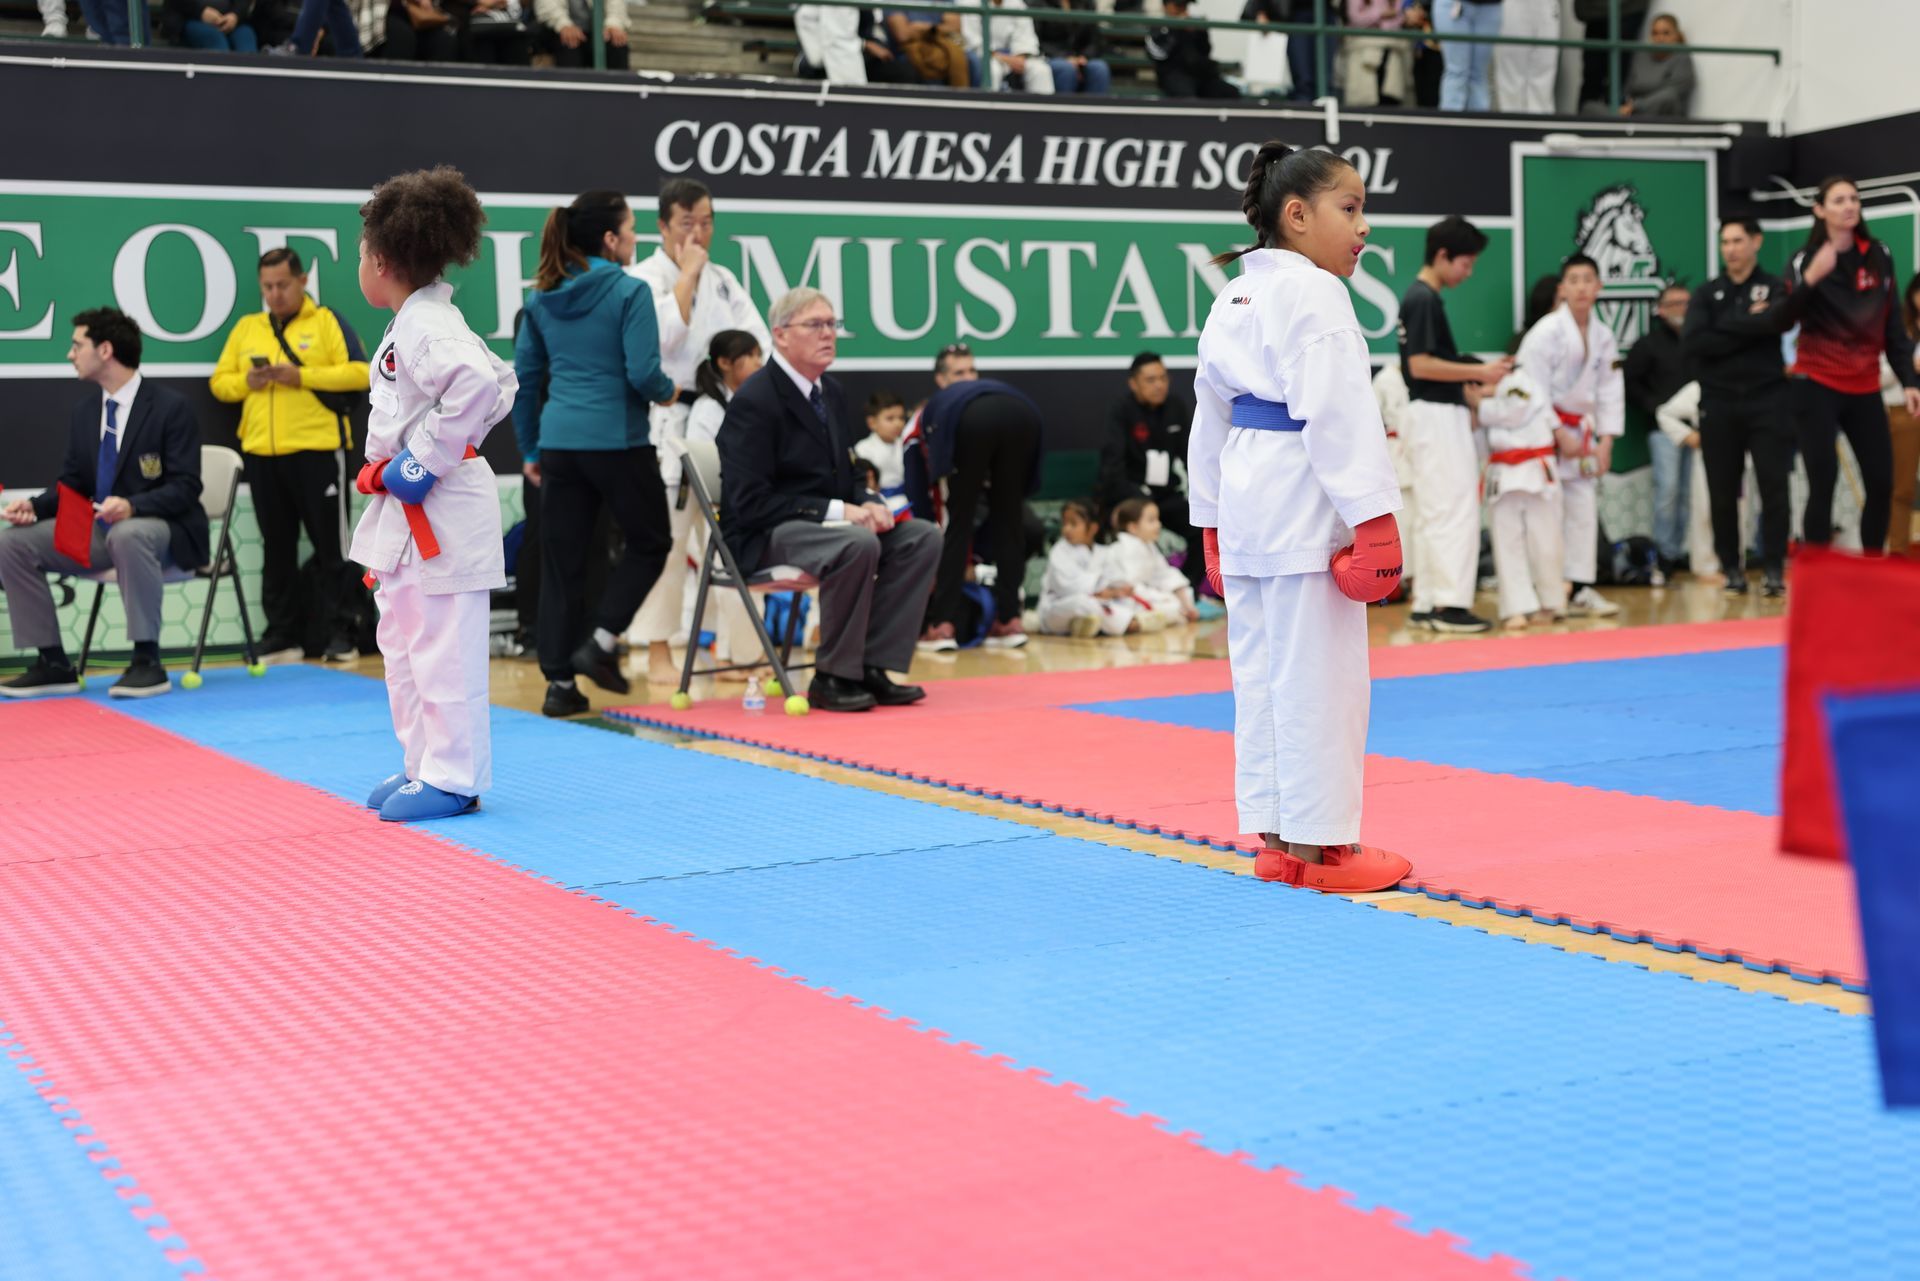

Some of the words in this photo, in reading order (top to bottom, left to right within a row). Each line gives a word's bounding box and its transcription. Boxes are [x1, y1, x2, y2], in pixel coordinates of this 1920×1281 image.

[654, 119, 850, 178] COSTA
[860, 128, 1025, 184] MESA
[1034, 135, 1188, 188] HIGH
[1191, 140, 1400, 194] SCOL
[728, 234, 1401, 341] MUSTANS
